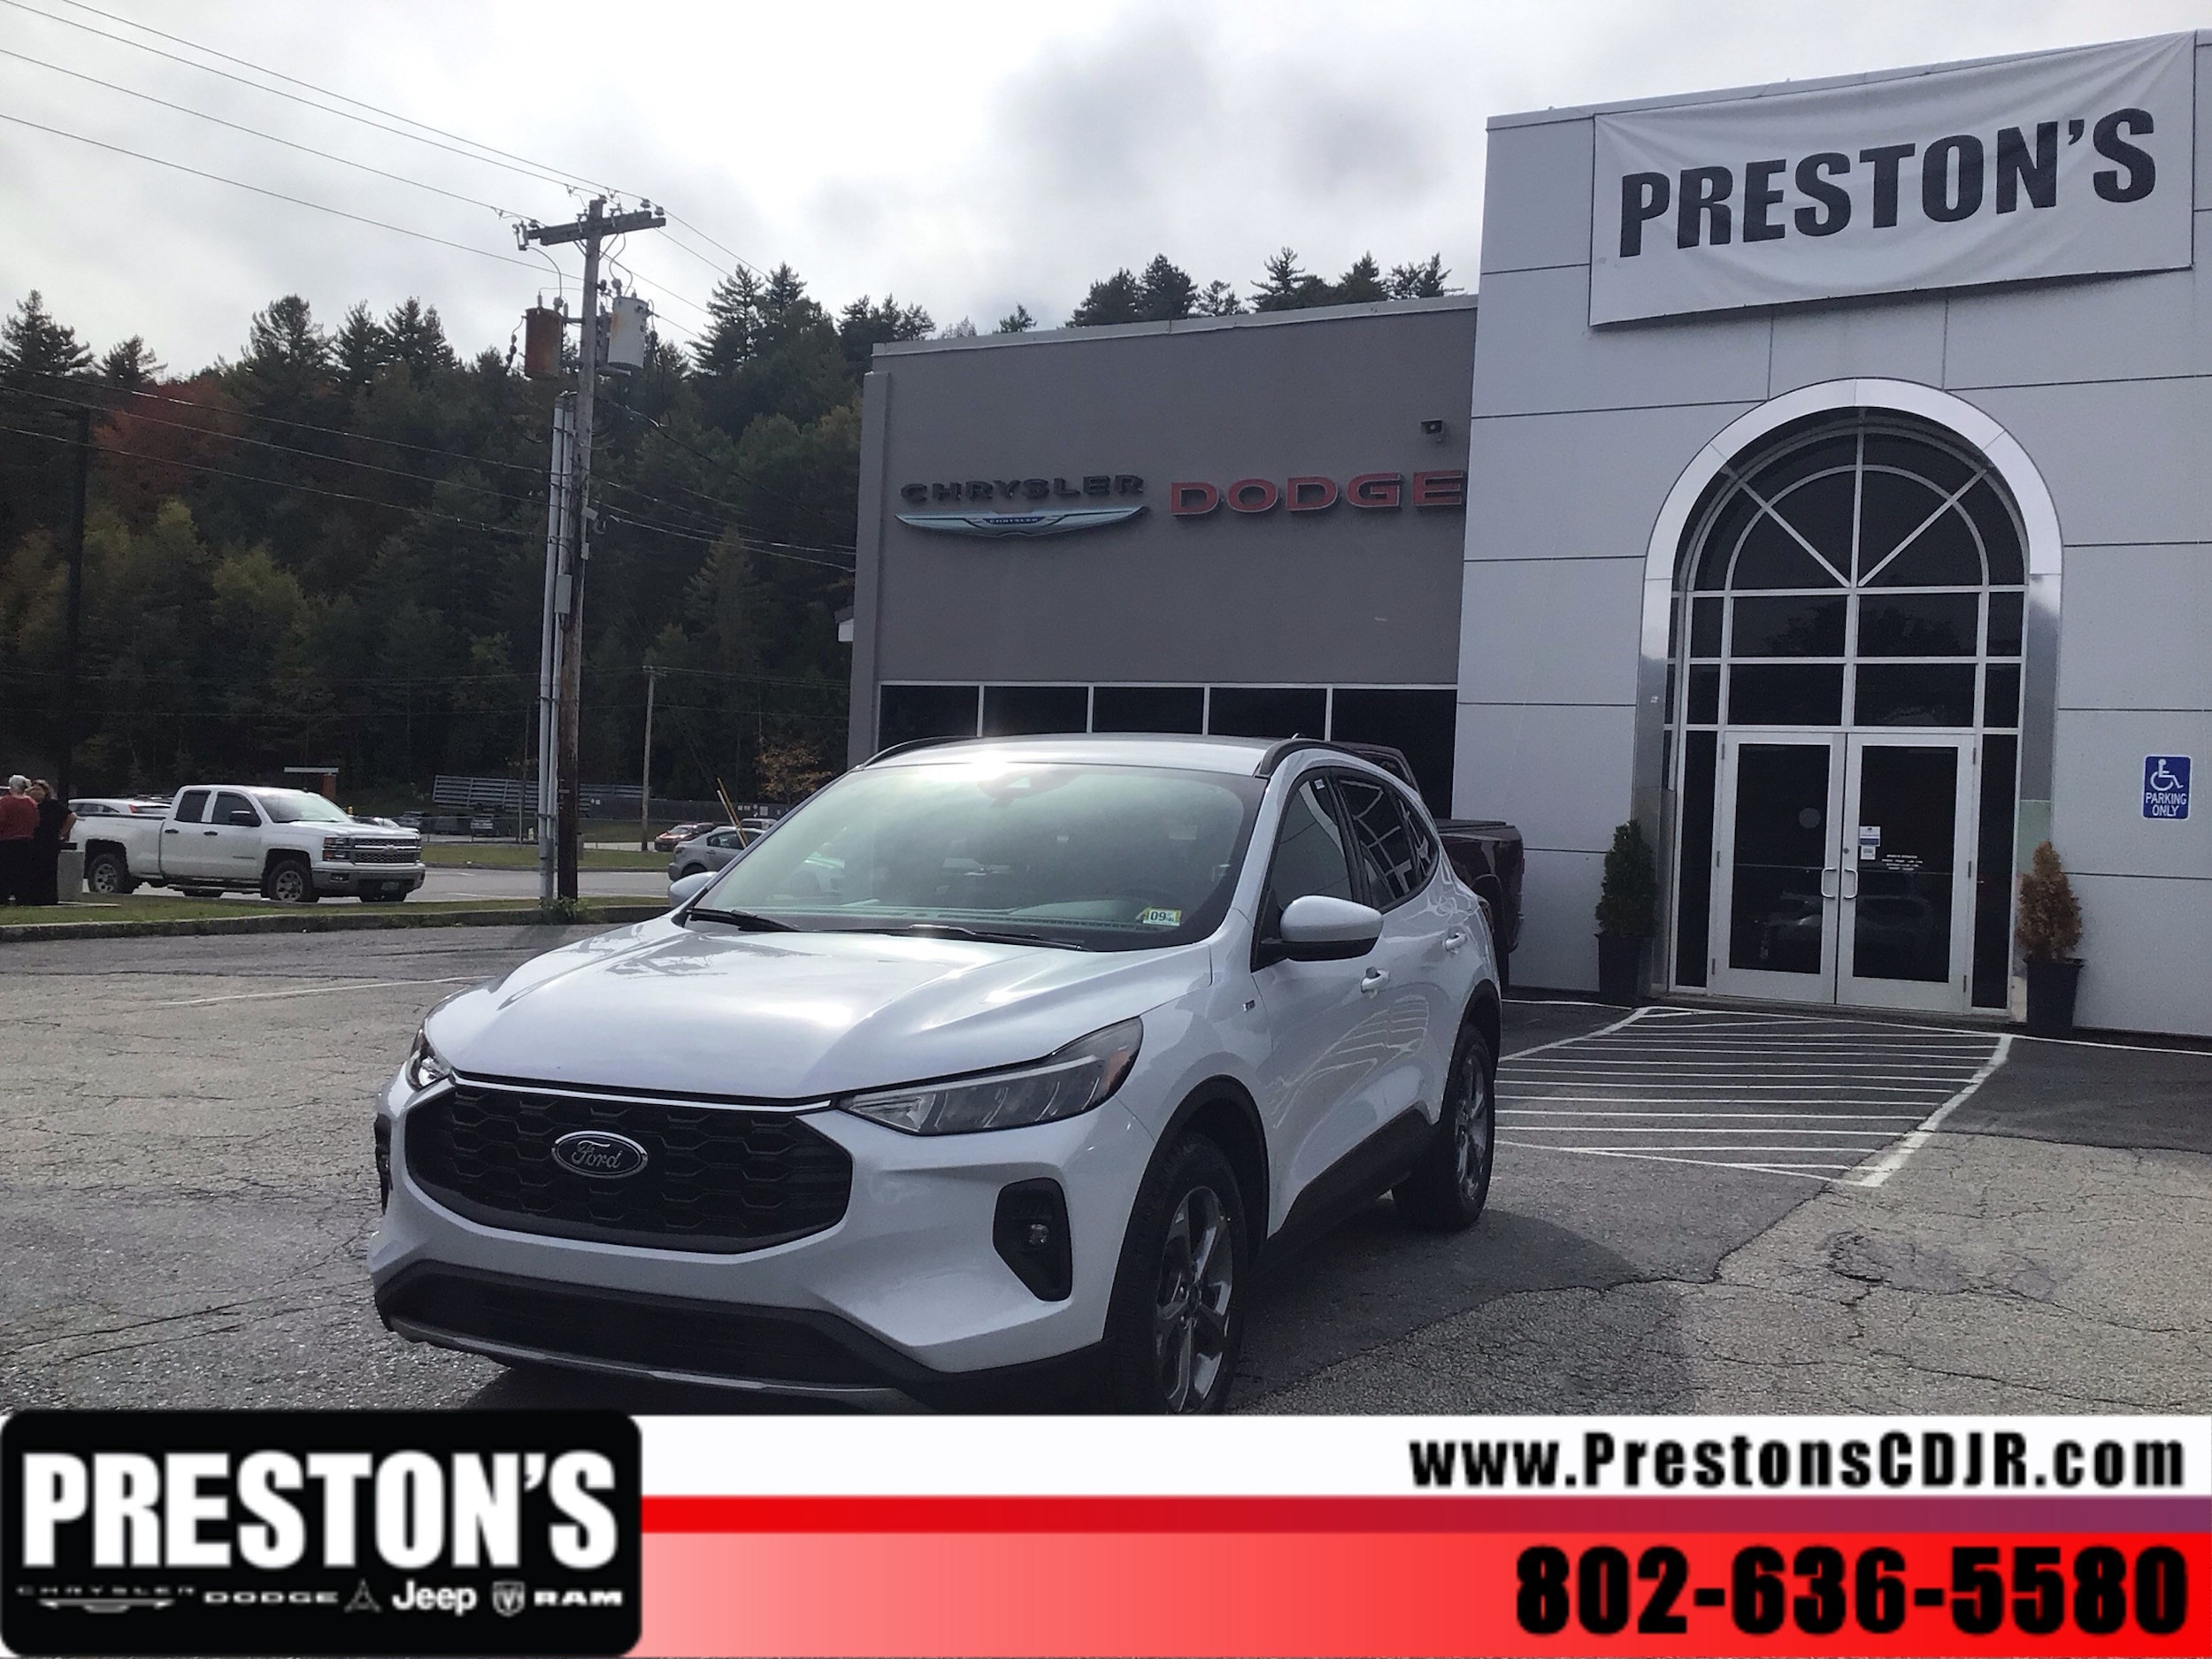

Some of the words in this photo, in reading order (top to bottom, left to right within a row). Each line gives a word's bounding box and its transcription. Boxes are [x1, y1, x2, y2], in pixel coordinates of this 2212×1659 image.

[1619, 108, 2156, 257] PRESTON'S
[900, 473, 1145, 504] CHRYSLER
[1171, 470, 1465, 518] DODGE
[2145, 792, 2187, 805] PARKING
[2152, 804, 2179, 817] ONLY
[1150, 910, 1167, 921] 09
[571, 1140, 623, 1168] Ford
